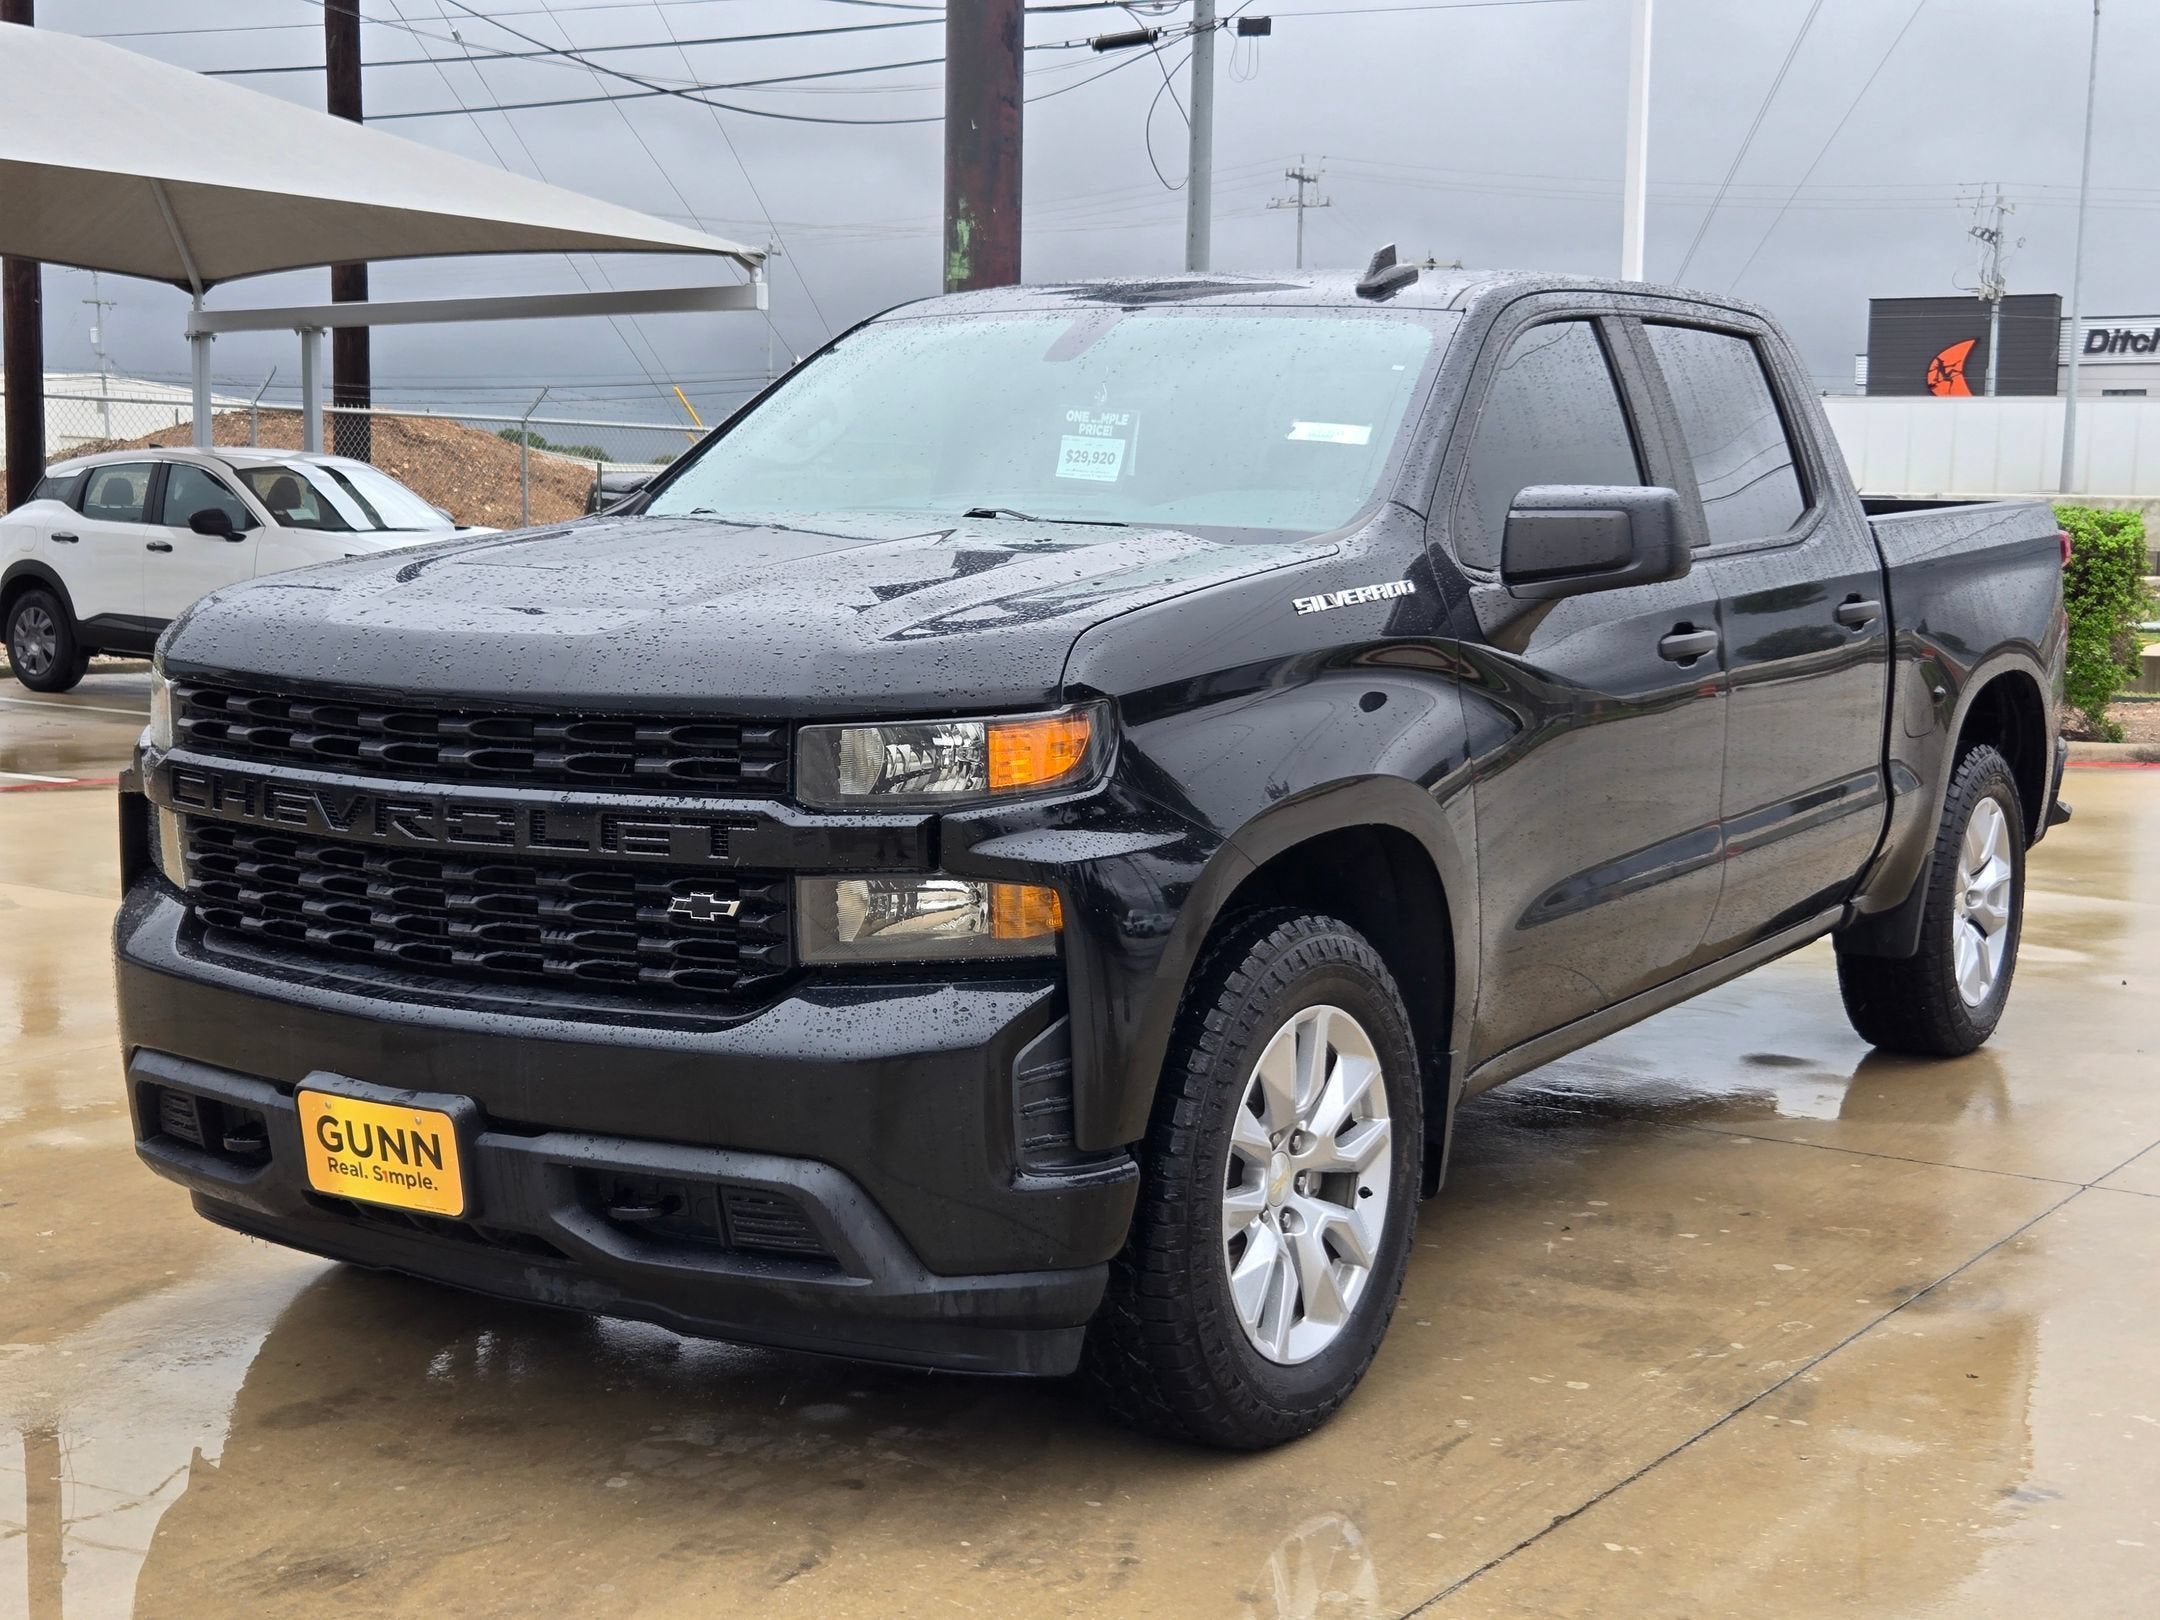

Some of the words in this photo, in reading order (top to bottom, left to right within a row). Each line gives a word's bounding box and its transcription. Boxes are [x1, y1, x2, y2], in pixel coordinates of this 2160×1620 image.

[1066, 409, 1090, 422] ONE
[1091, 412, 1130, 425] MPLE
[1065, 449, 1116, 465] $29,920
[1292, 579, 1416, 616] SILVERADO
[171, 767, 758, 860] CHEVROLET
[316, 1115, 443, 1170] GUNN
[327, 1156, 369, 1180] Real.
